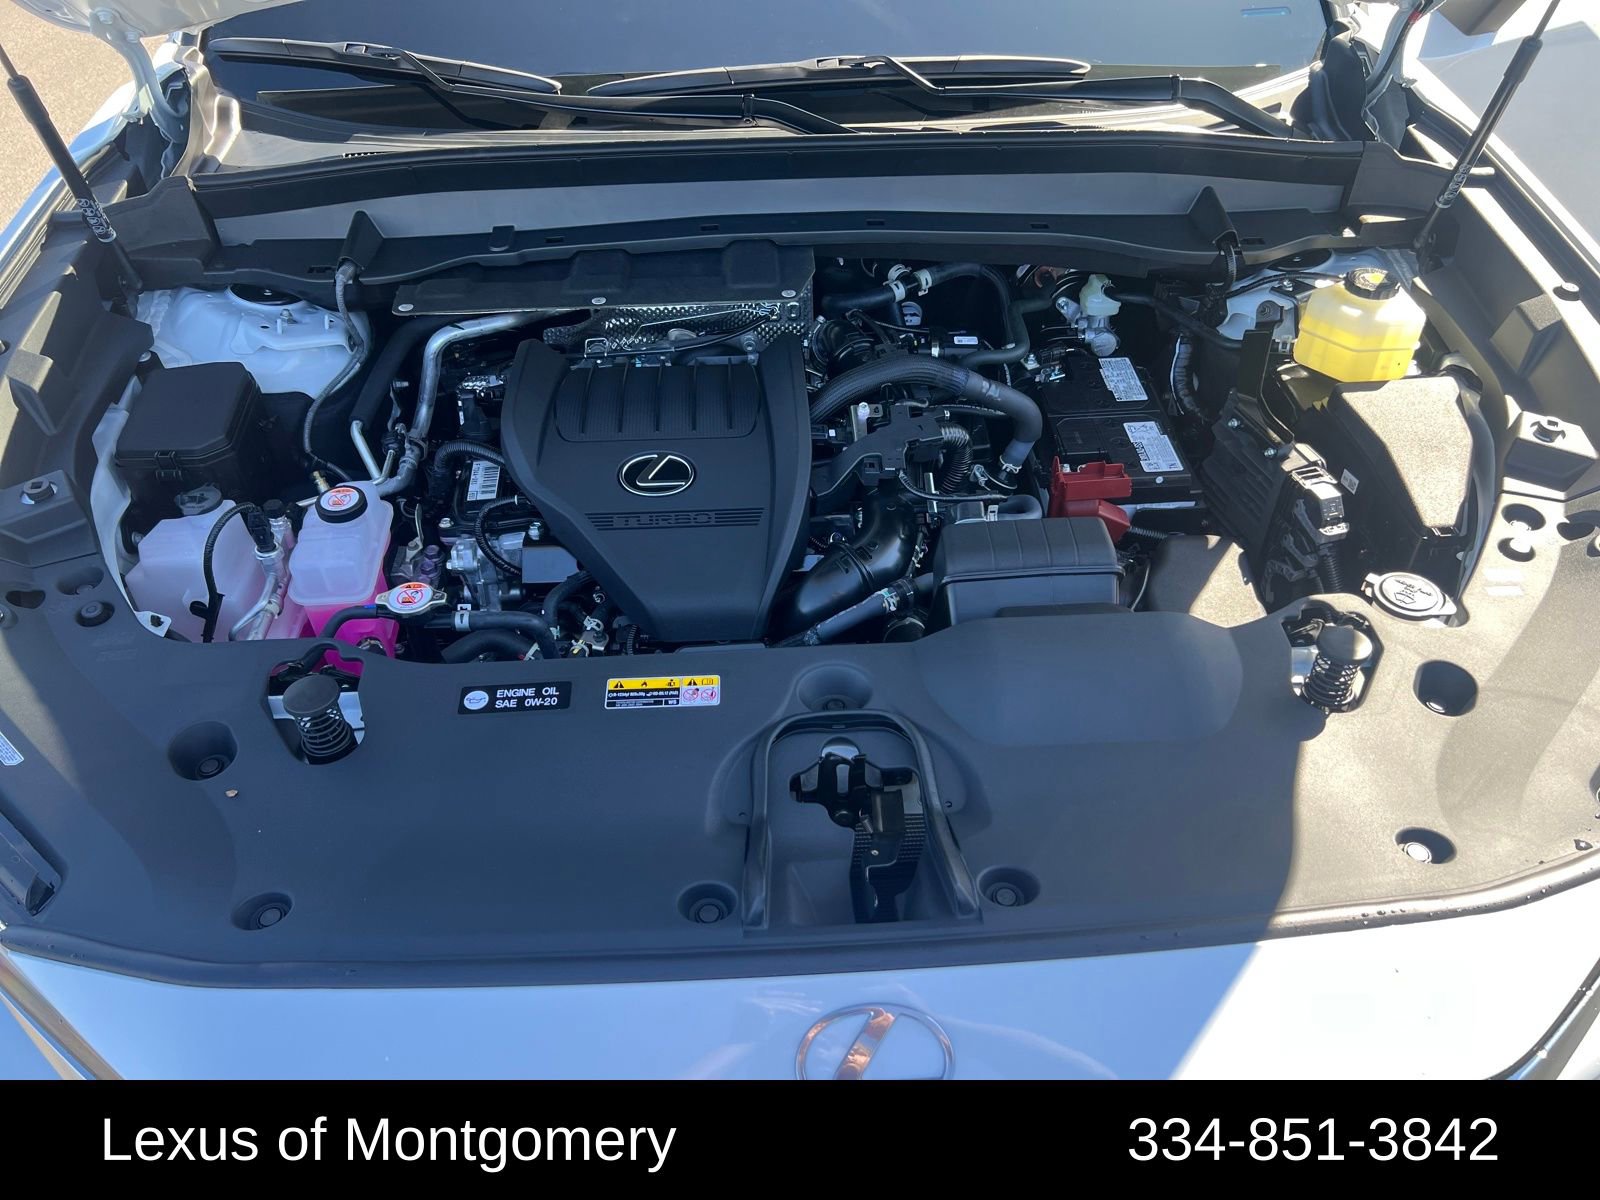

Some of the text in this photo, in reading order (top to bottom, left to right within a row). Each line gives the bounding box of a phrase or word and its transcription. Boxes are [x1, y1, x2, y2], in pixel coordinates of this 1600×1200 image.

[615, 512, 712, 527] TURBO
[496, 686, 560, 698] ENGINE OIL
[494, 697, 558, 709] SAE 0W-20
